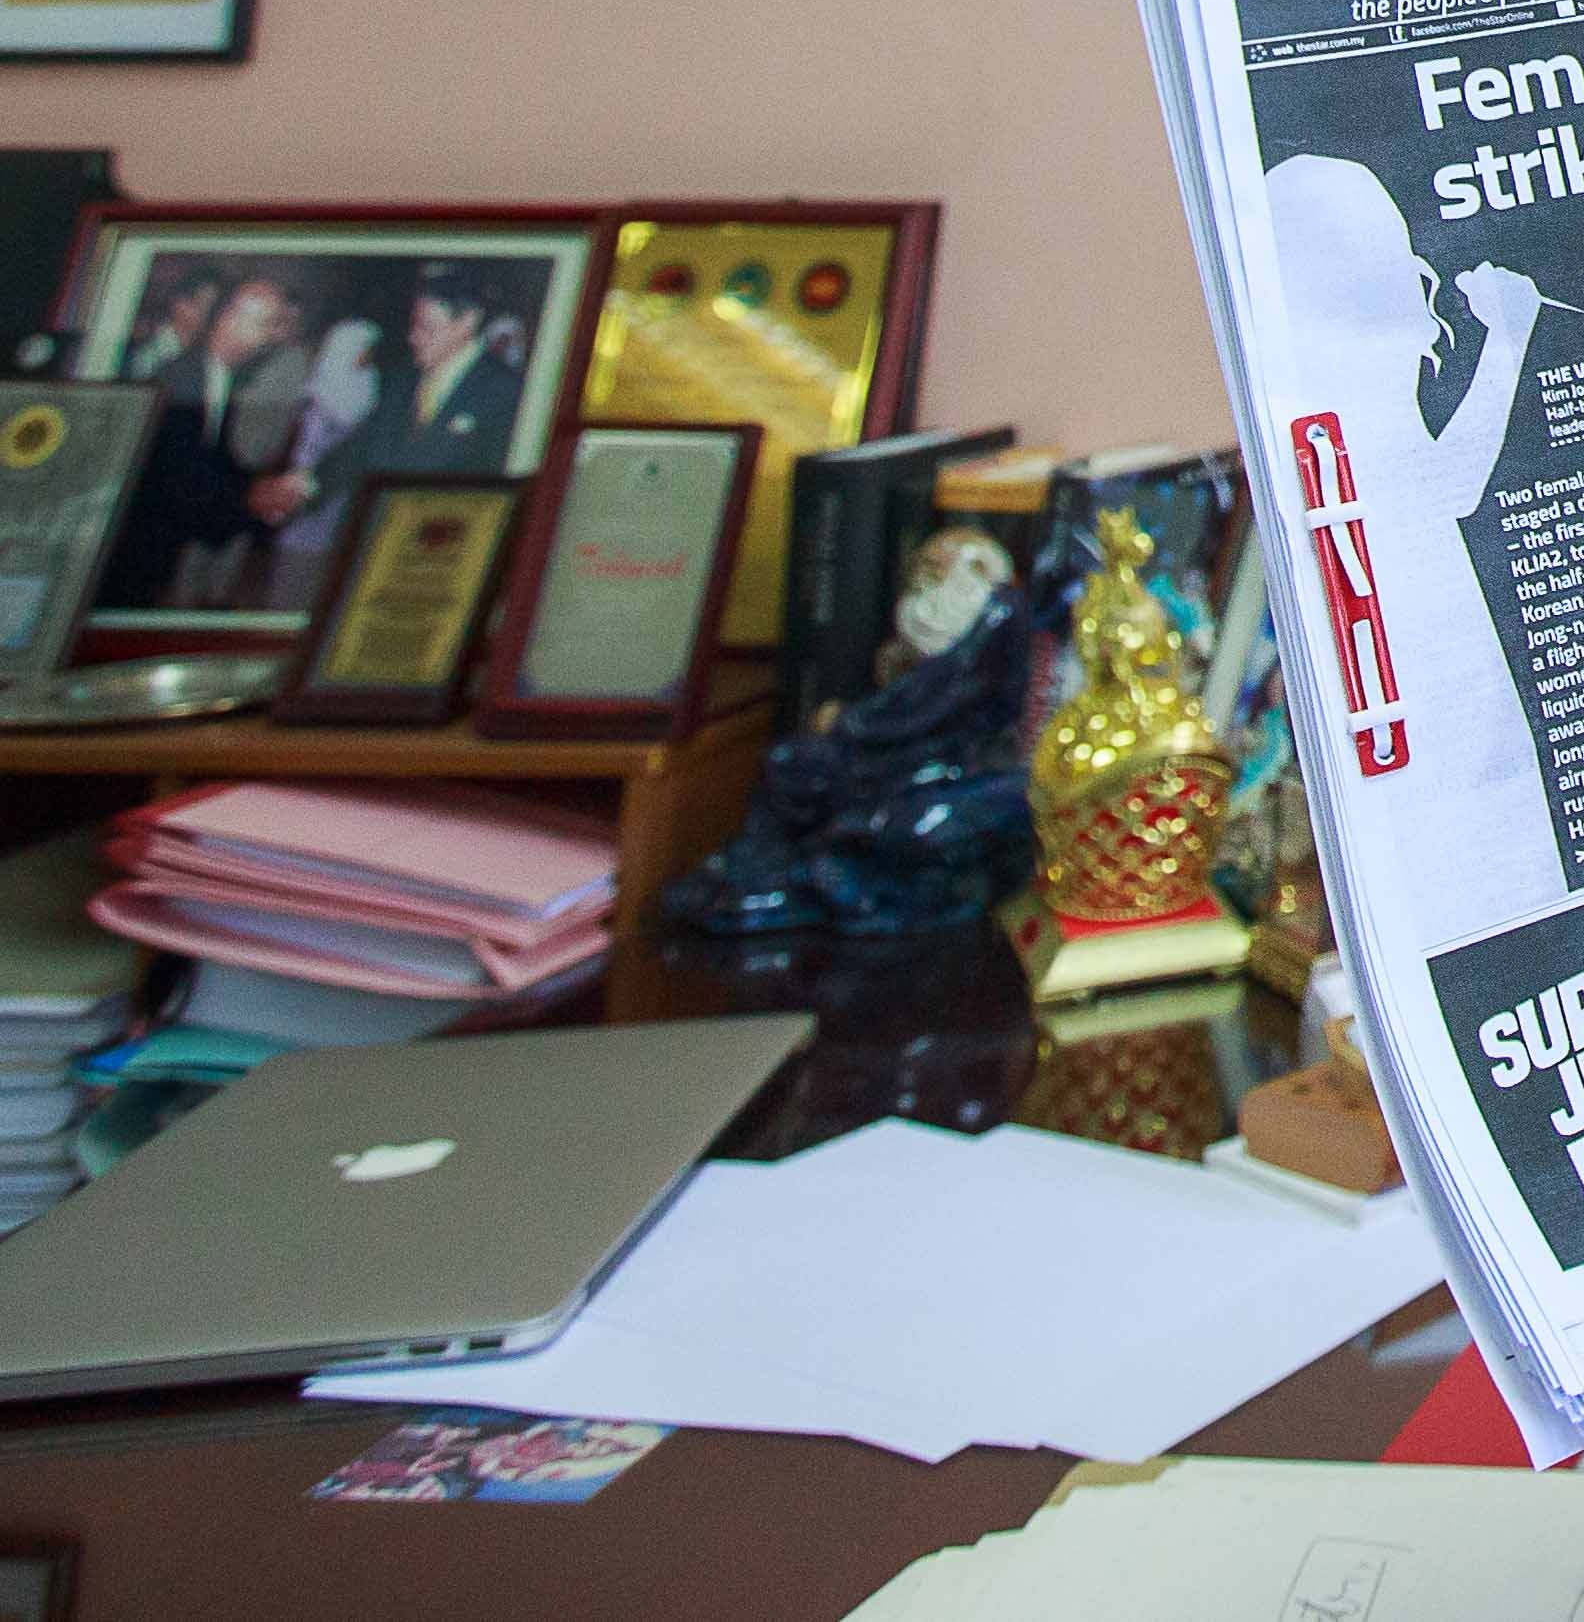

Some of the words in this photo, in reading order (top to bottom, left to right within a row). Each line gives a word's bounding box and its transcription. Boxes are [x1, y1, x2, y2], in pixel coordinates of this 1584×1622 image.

[1536, 365, 1573, 387] THE
[1541, 388, 1570, 404] Kim
[1494, 488, 1533, 508] Two
[1501, 500, 1561, 532] staged
[1563, 501, 1576, 515] a
[1522, 530, 1554, 549] the
[1510, 549, 1568, 577] KLIA2,
[1516, 581, 1547, 600] the
[1521, 595, 1584, 624] Korean
[1532, 657, 1545, 671] a
